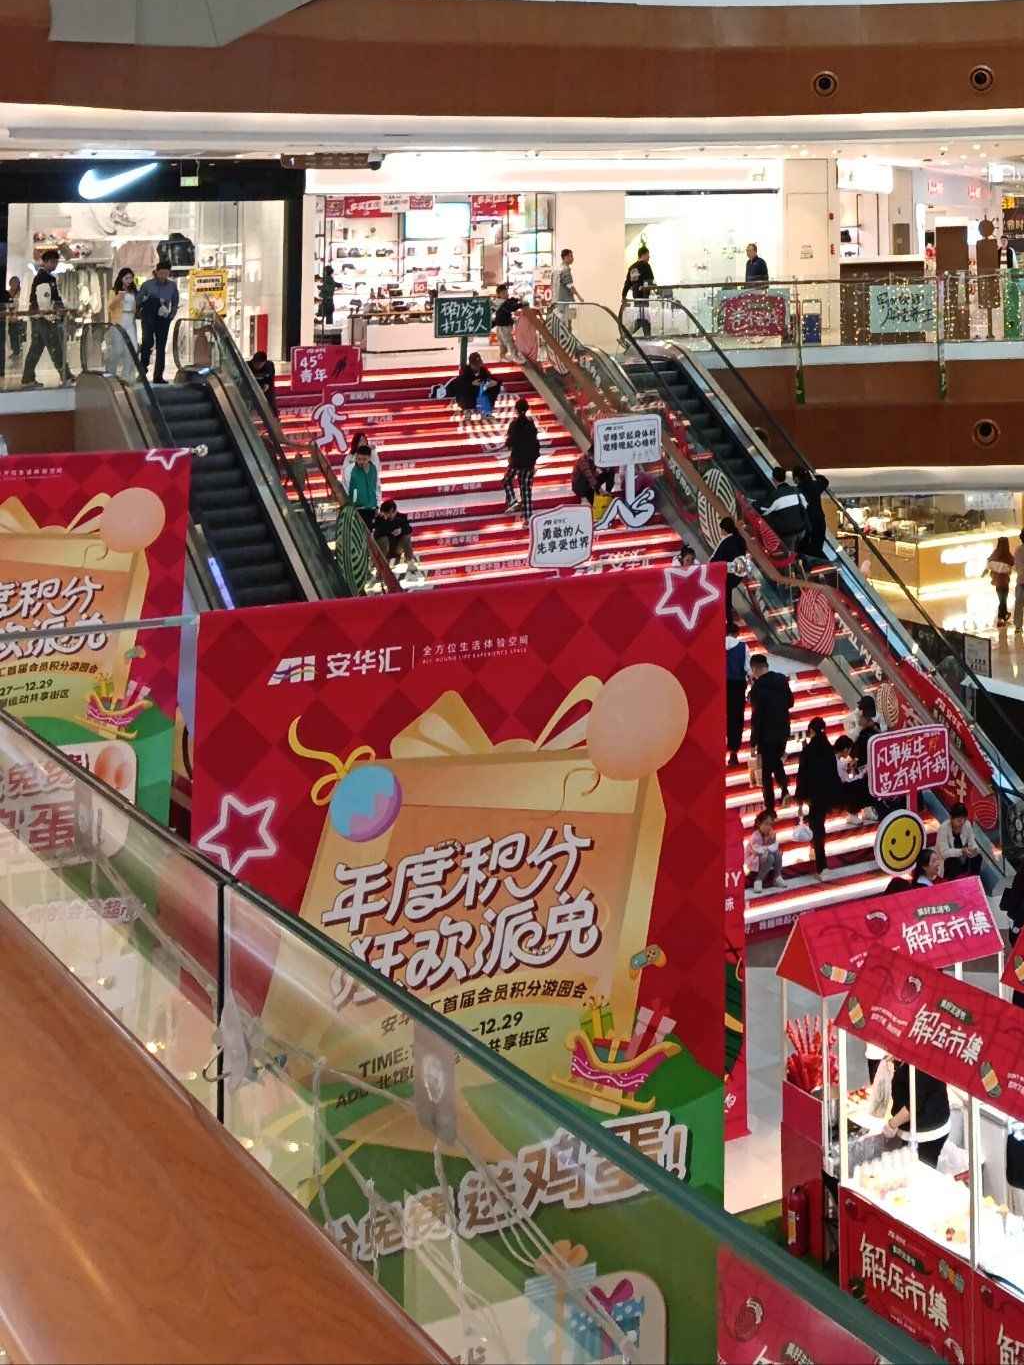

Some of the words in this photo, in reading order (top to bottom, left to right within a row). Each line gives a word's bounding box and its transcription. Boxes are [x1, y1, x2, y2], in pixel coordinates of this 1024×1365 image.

[300, 368, 328, 383] 青年
[602, 439, 657, 452] 晚睡晚起心情好
[603, 428, 657, 442] 早睡早起身体好
[542, 524, 584, 540] 勇敢的人
[536, 537, 590, 554] 先享受世界
[422, 634, 529, 656] 全方位生活体验空间
[326, 646, 402, 680] 安华汇
[321, 823, 593, 933] 年度积分
[902, 910, 992, 955] 解压市集
[908, 1003, 985, 1066] 解压市集
[859, 1232, 952, 1332] 解压市集
